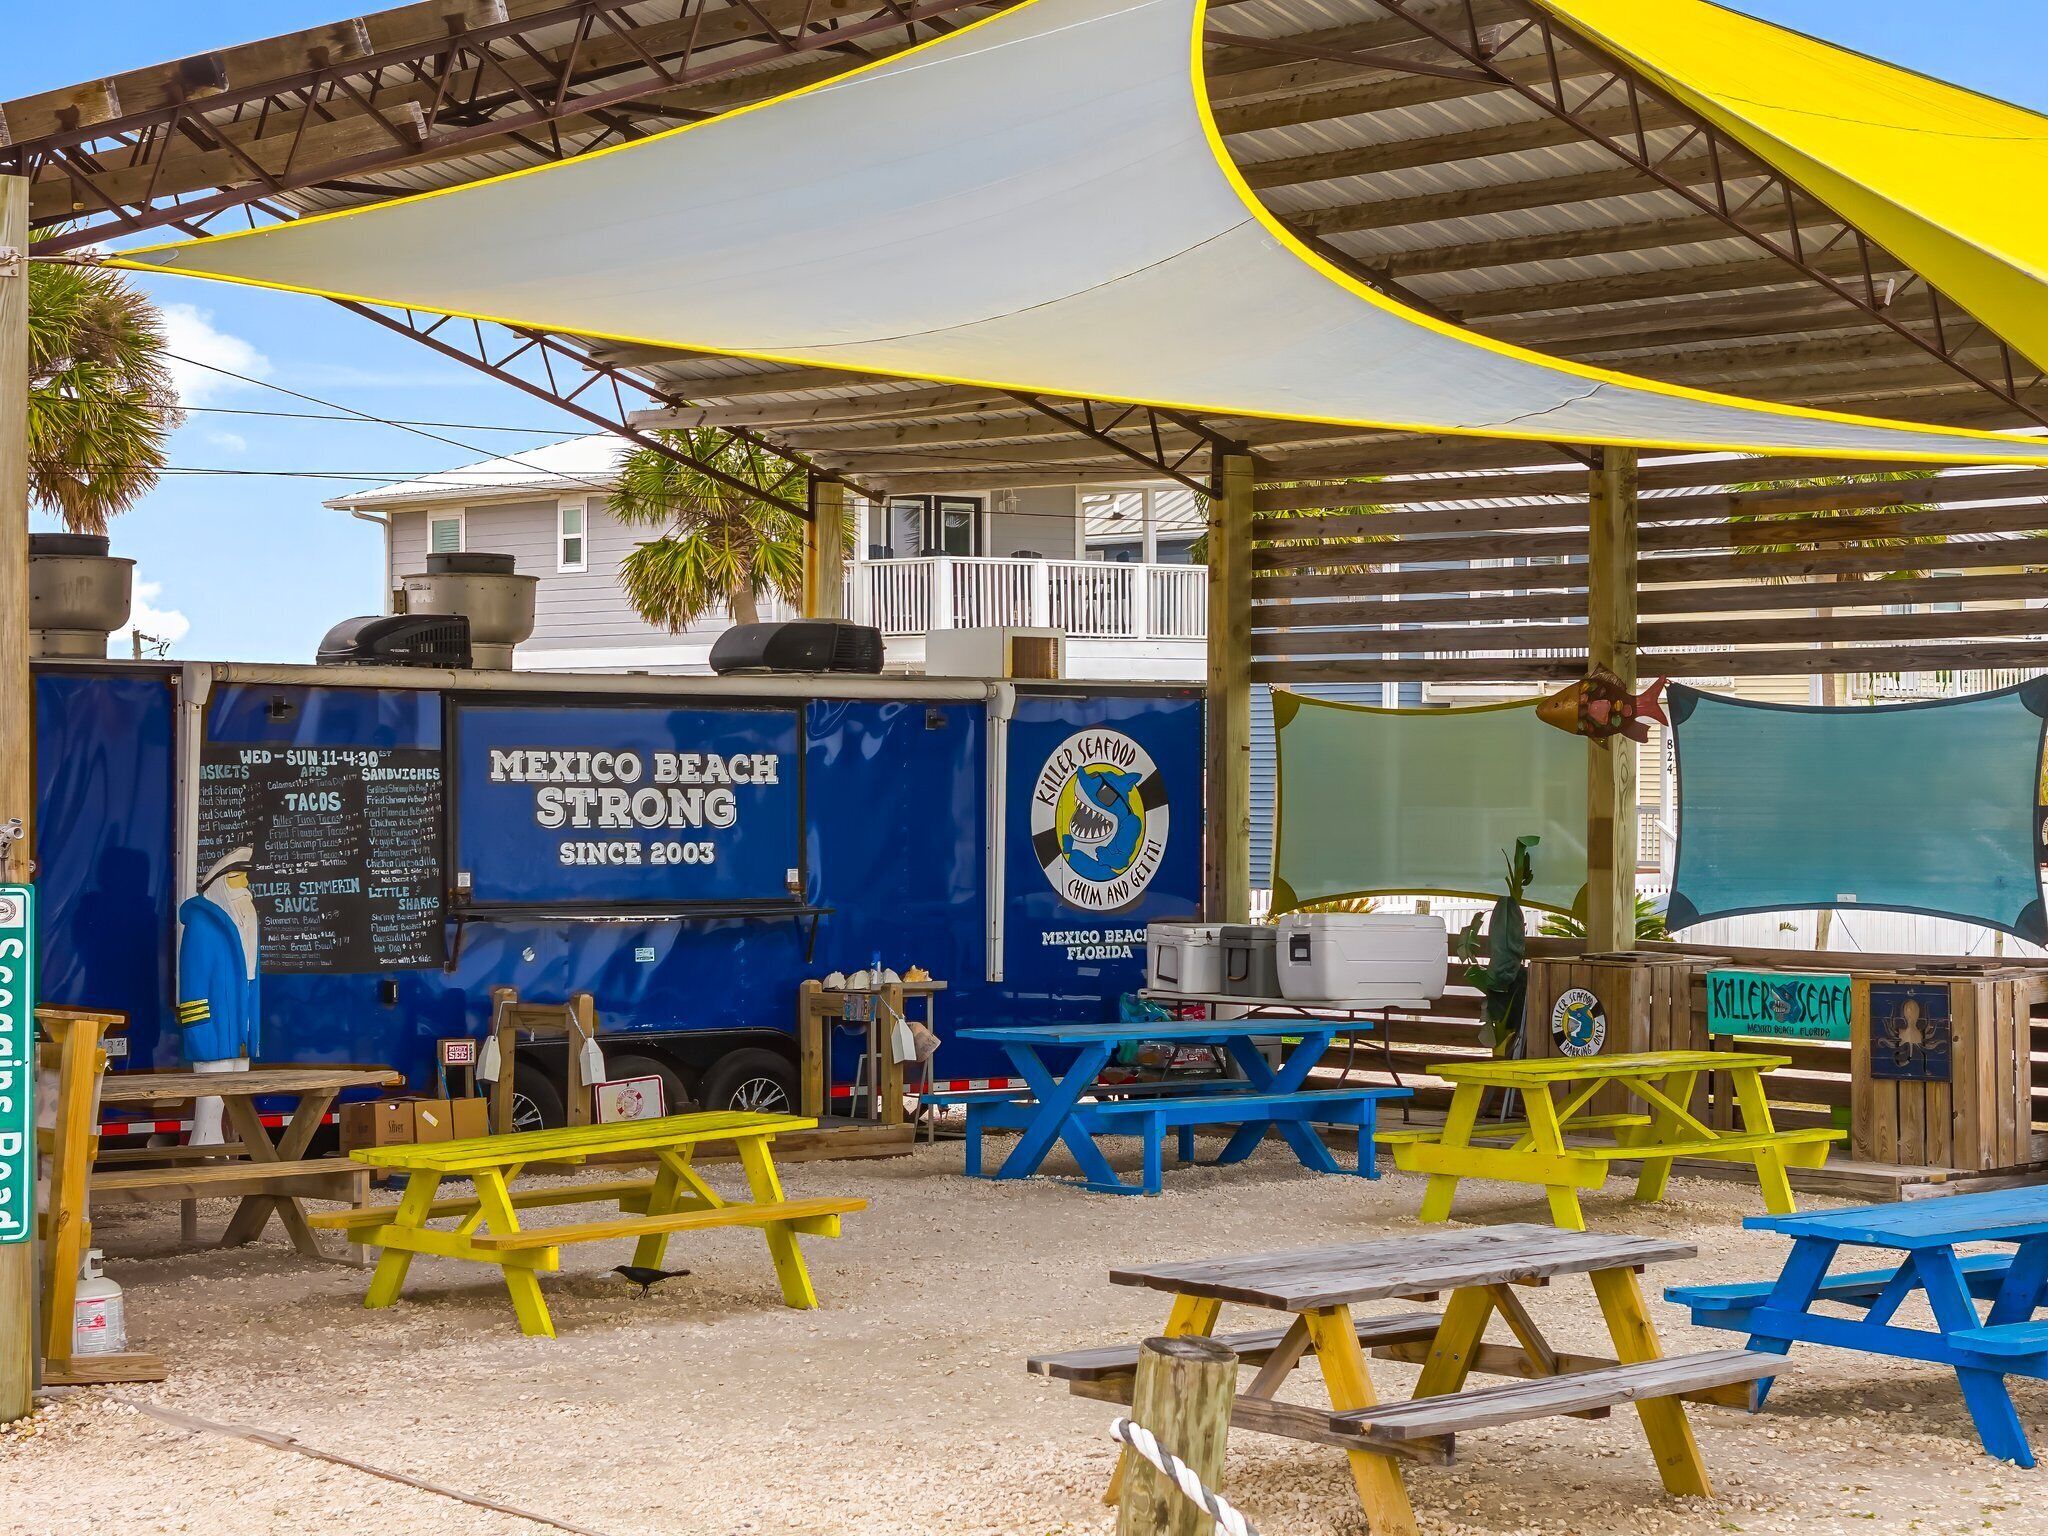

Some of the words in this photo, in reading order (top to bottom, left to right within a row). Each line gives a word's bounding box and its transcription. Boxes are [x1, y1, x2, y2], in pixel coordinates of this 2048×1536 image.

[1078, 736, 1136, 767] SEAFOOD
[199, 764, 250, 779] ASKETS
[300, 766, 328, 777] APPS
[361, 767, 441, 781] SANDWICHES
[490, 750, 642, 783] MEXICO
[654, 753, 779, 784] BEACH
[284, 791, 342, 812] TACOS
[536, 787, 737, 829] STRONG
[198, 810, 213, 820] ried
[559, 842, 642, 865] SINCE
[650, 842, 715, 865] 2003
[299, 877, 361, 895] SIMMERIN
[1068, 879, 1102, 906] CHUM
[1107, 880, 1129, 904] AND
[1131, 861, 1152, 888] GET
[367, 886, 411, 899] LITTLE
[274, 896, 320, 913] SAUCE
[398, 896, 441, 911] SHARKS
[1042, 930, 1100, 946] MEXICO
[1067, 945, 1133, 960] FLORIDA
[1797, 982, 1851, 1025] SEAFO
[1593, 1021, 1604, 1046] ONLY
[1747, 1022, 1772, 1034] MEXICO
[1774, 1025, 1794, 1035] BEACH
[1799, 1027, 1831, 1037] FLORIDA
